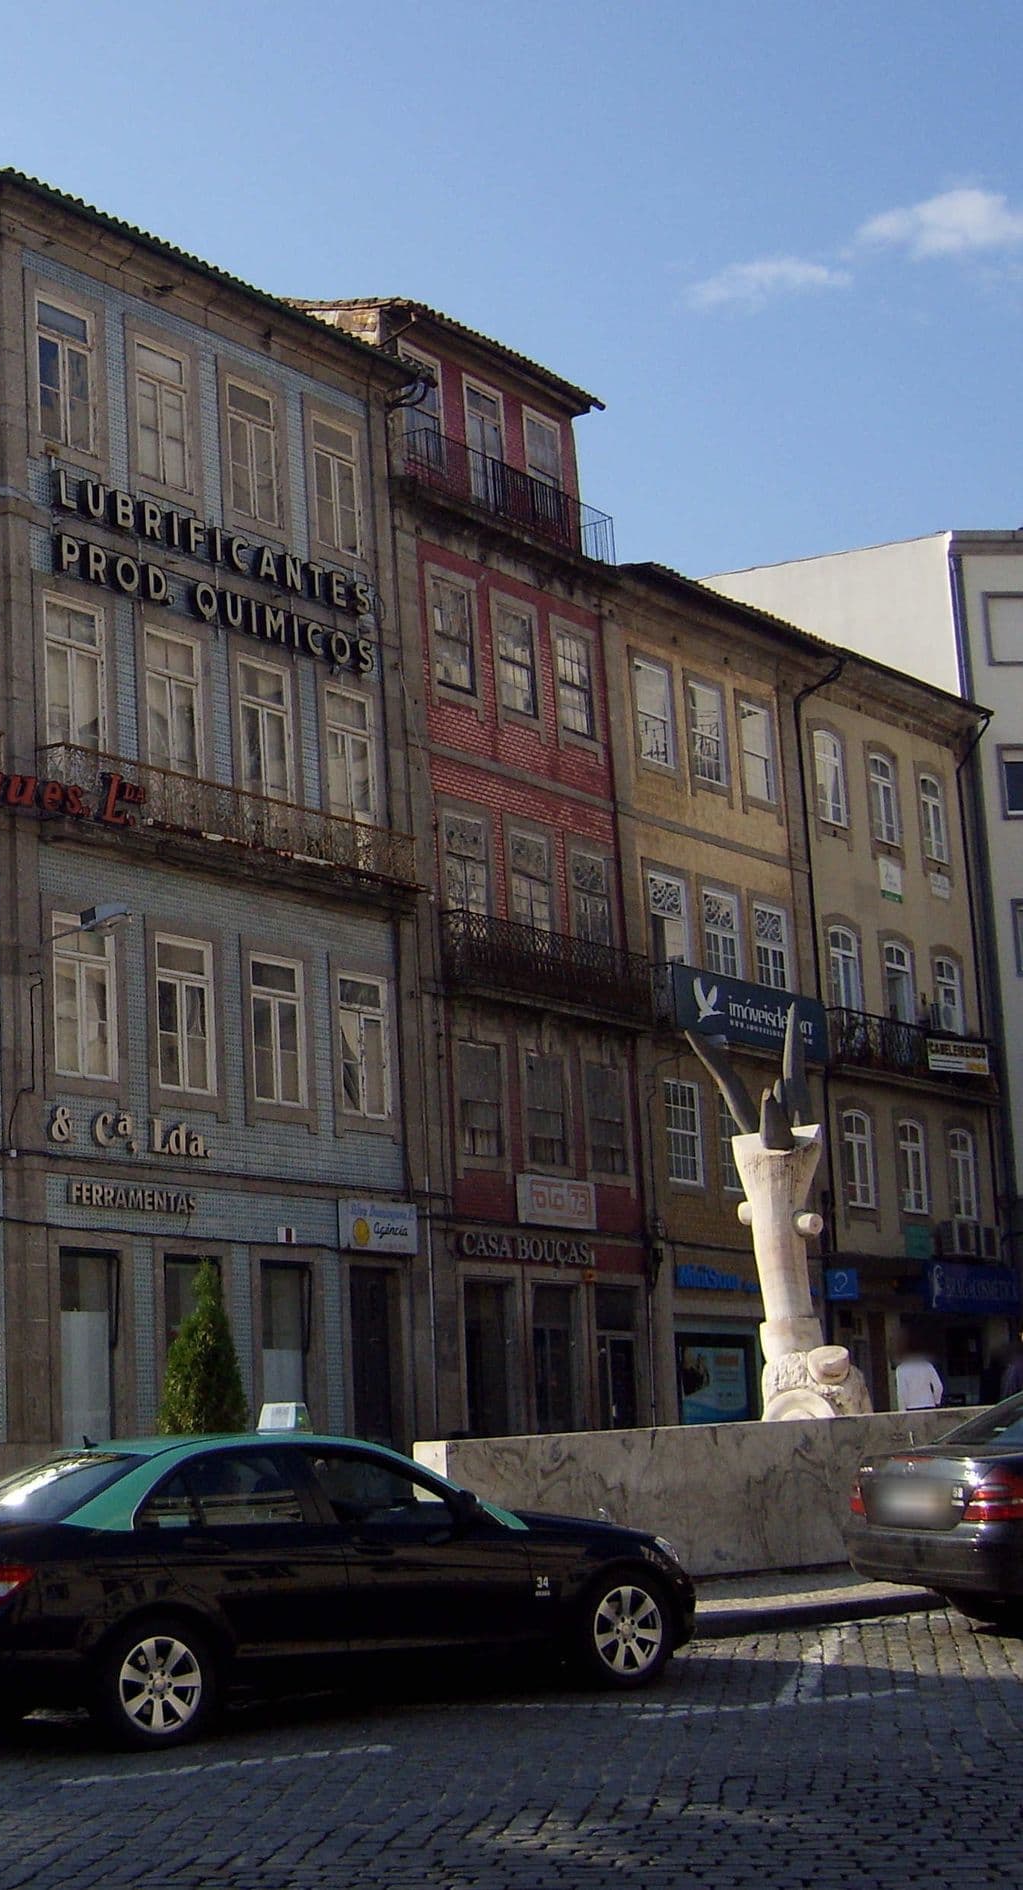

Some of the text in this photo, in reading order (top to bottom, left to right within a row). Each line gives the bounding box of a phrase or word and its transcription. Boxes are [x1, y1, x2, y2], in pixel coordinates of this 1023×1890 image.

[58, 469, 373, 616] LUBRIFICANTES
[59, 535, 374, 673] PROD. QUIMICOS
[51, 1106, 77, 1143] &
[151, 1118, 213, 1158] Lda.
[71, 1182, 197, 1214] FERRAMENTAS
[462, 1231, 590, 1265] CASA BOUÇAS
